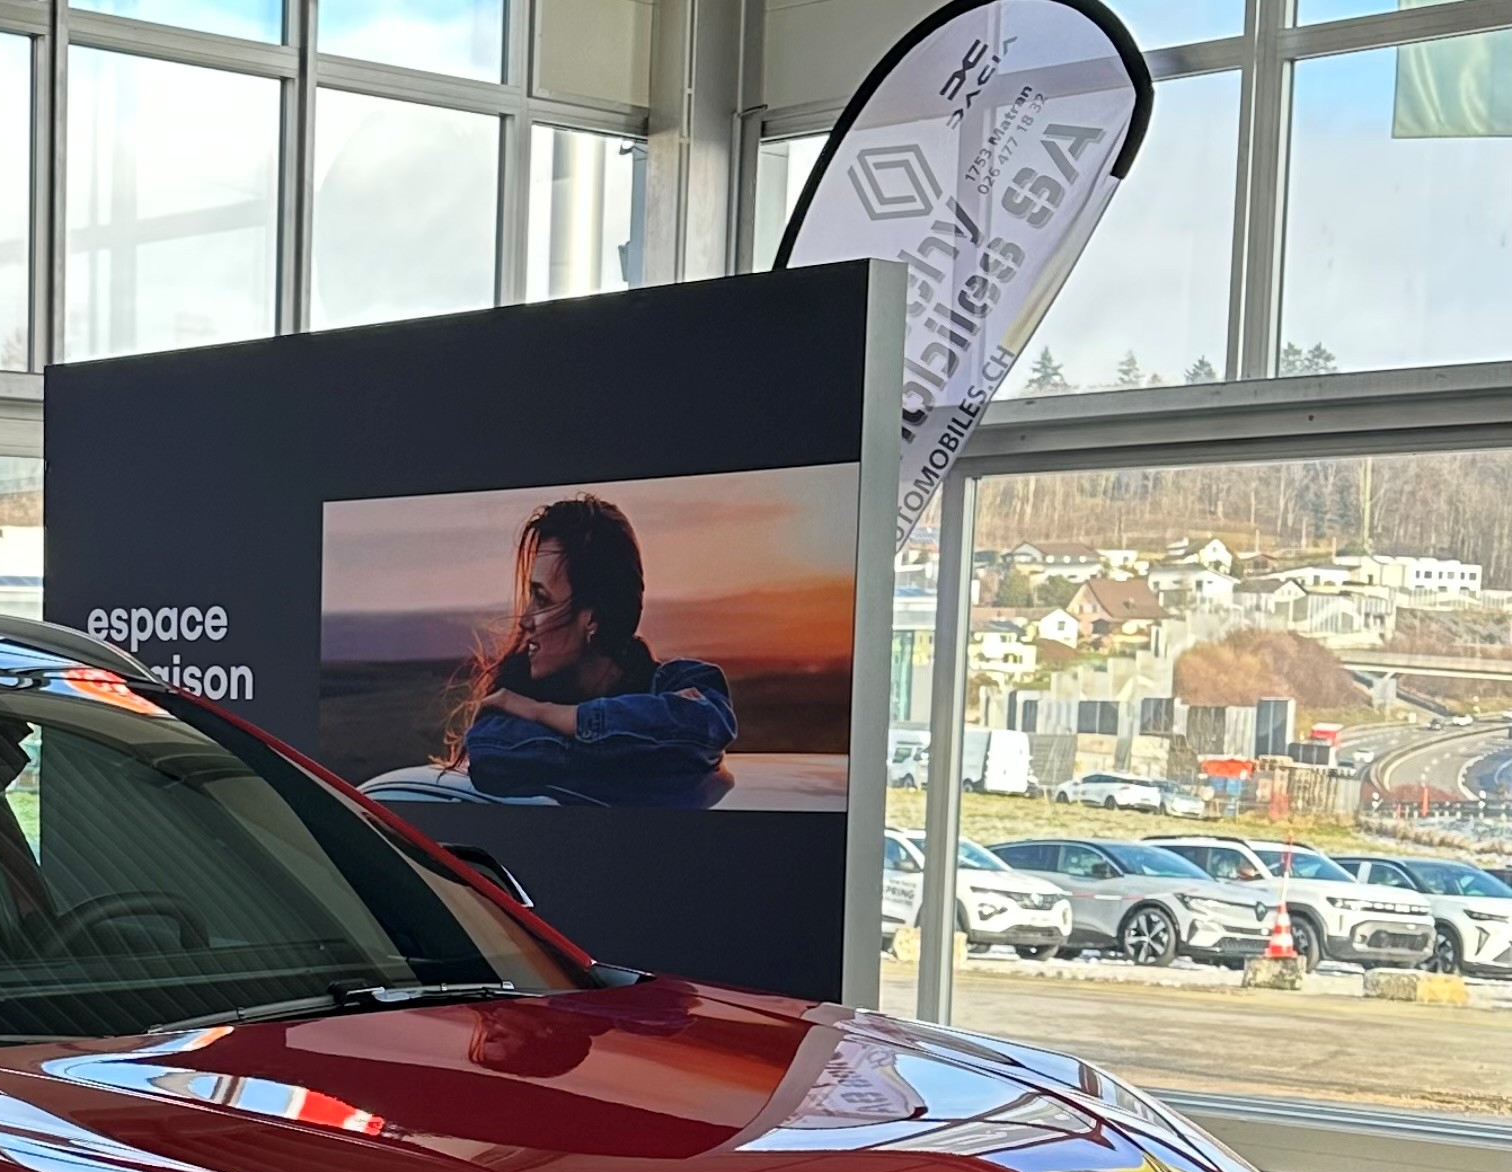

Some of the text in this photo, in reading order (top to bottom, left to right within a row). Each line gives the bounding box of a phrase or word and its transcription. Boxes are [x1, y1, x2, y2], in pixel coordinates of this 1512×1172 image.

[947, 36, 1018, 130] DACIA
[965, 86, 1033, 182] 1753 Matran
[977, 93, 1049, 195] 026 477 18 32
[901, 123, 1105, 443] obiles SA
[88, 605, 228, 652] espace
[150, 654, 254, 700] aison
